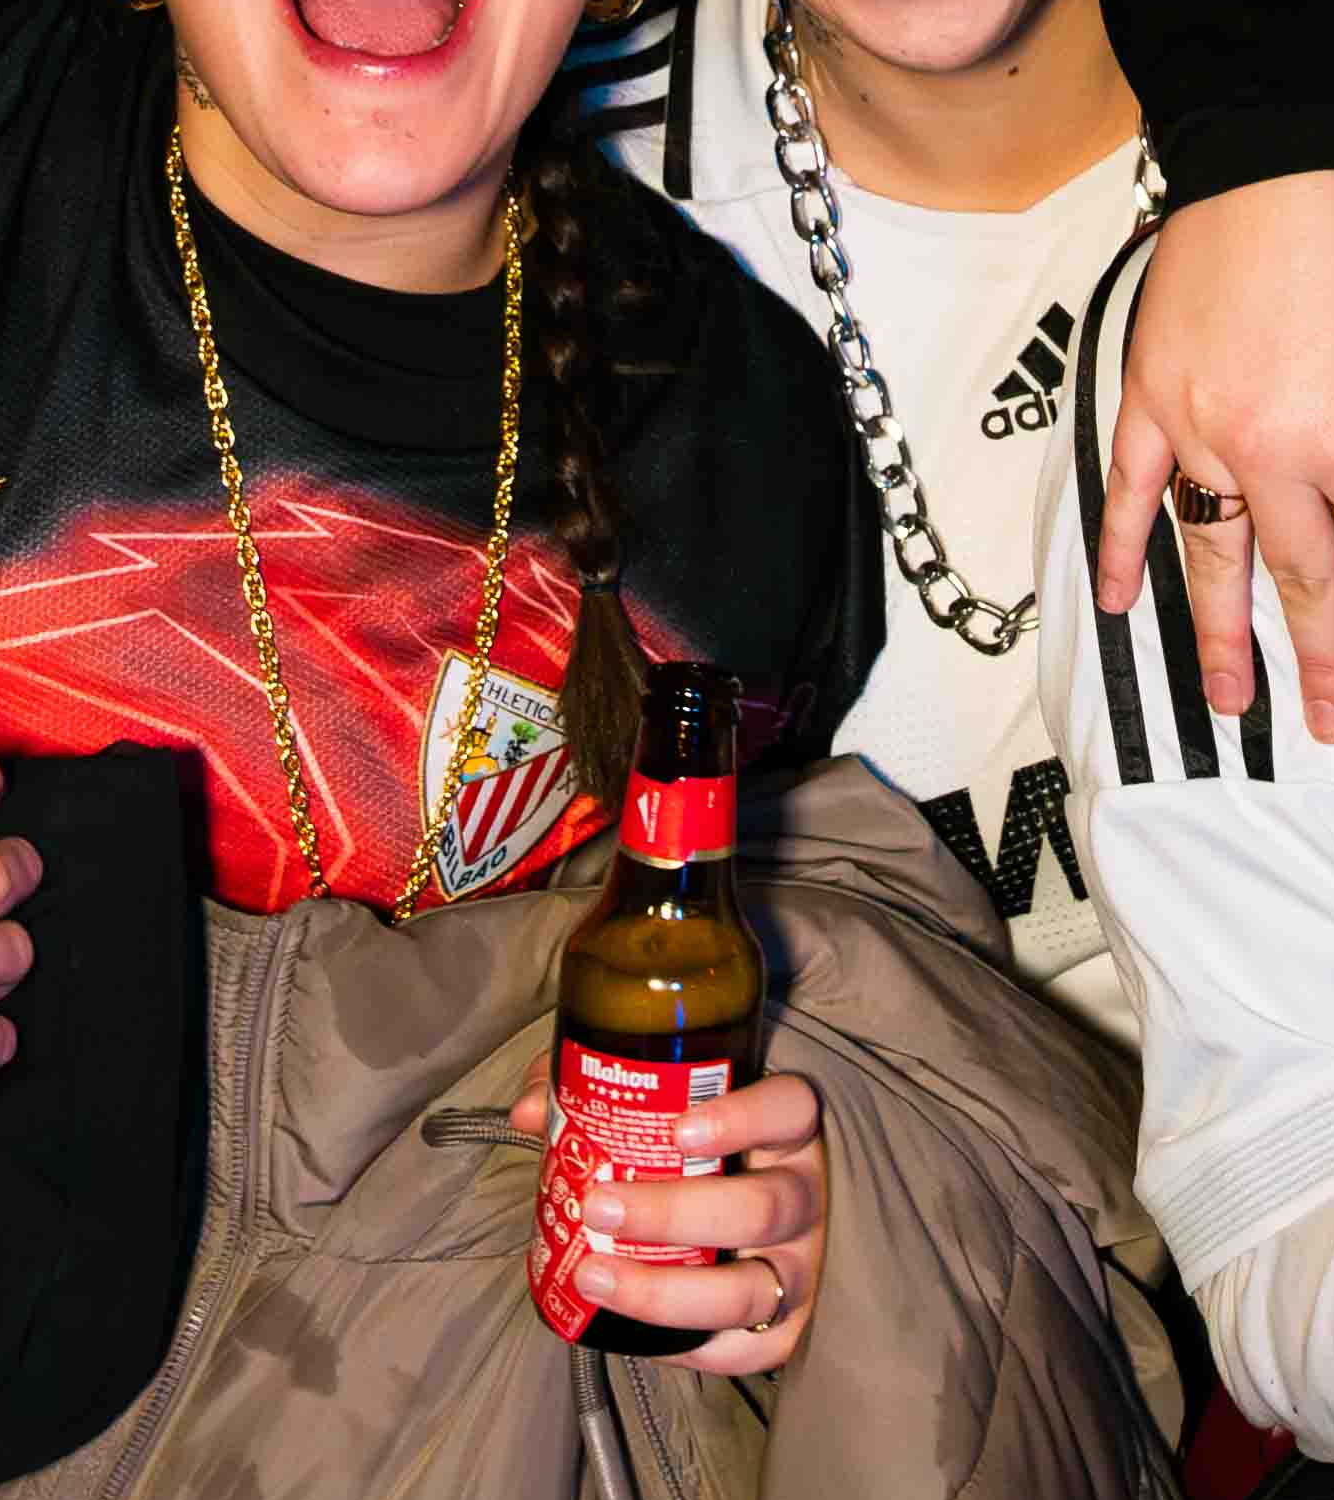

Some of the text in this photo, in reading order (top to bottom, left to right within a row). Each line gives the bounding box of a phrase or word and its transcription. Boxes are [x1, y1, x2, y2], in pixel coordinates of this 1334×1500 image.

[981, 387, 1058, 440] adi
[482, 679, 554, 722] THLETIC
[441, 824, 509, 893] BILBAO
[579, 1053, 660, 1091] Mahou
